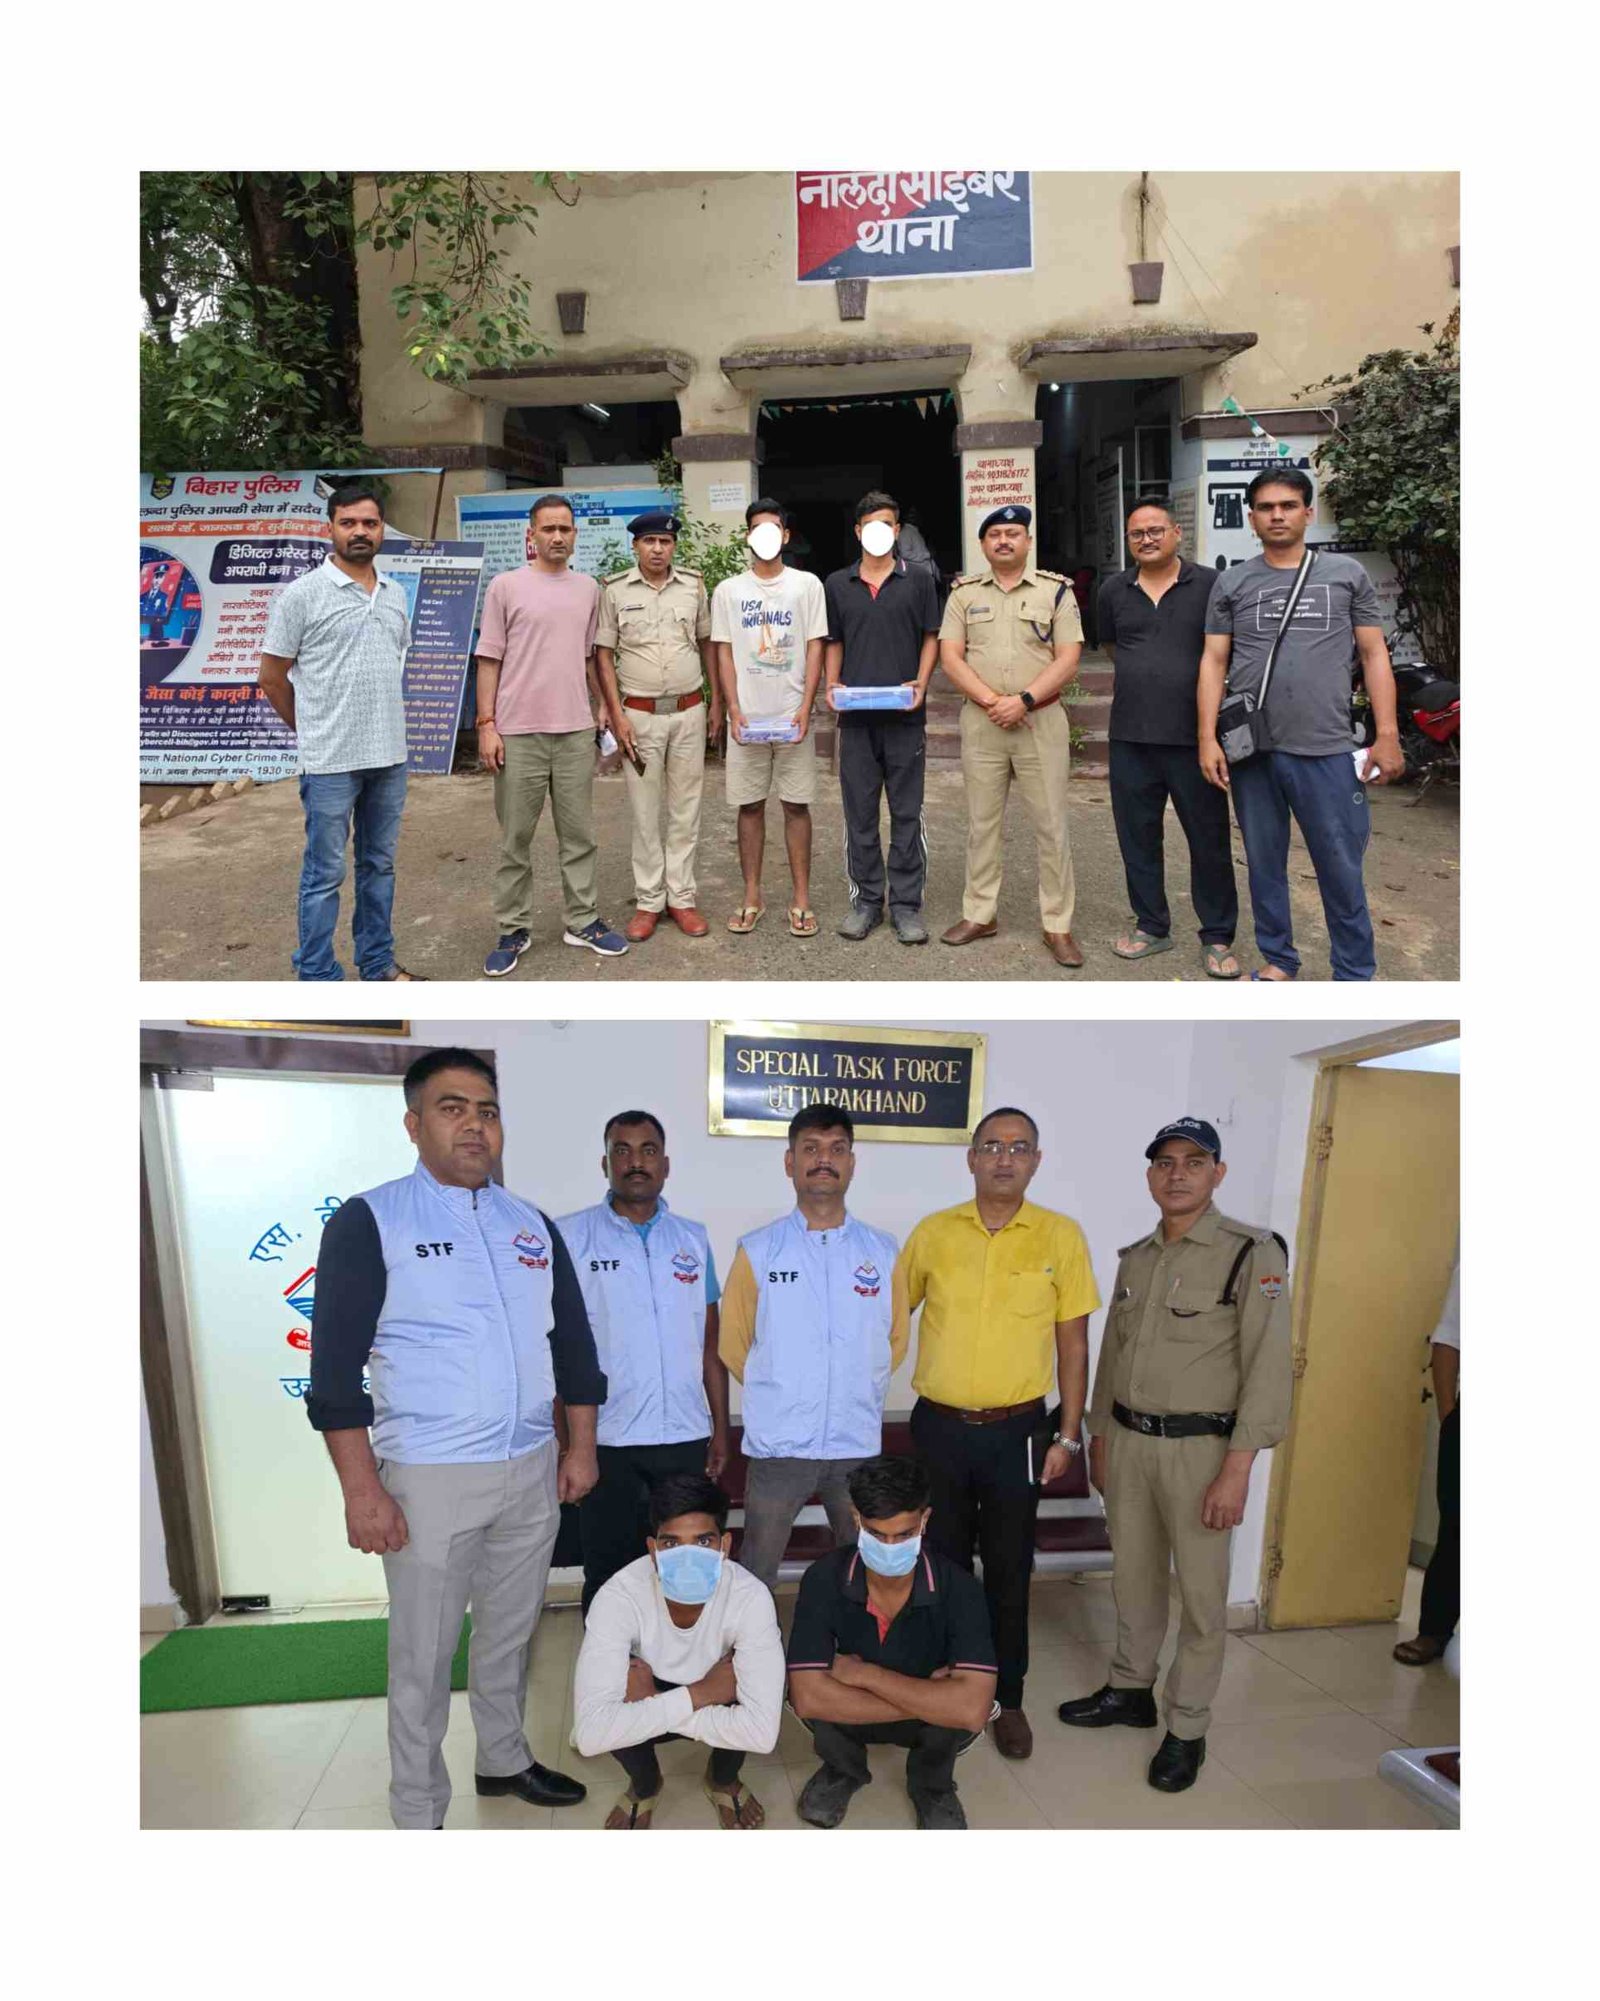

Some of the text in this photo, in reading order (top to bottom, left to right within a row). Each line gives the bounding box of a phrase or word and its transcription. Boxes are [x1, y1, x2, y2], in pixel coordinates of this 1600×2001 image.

[856, 215, 960, 254] थाना
[185, 475, 302, 500] बिहार पुलिस
[171, 504, 204, 519] पुलिस
[208, 503, 247, 515] आपकी
[251, 503, 273, 514] सेवा
[277, 502, 289, 513] में
[229, 544, 272, 560] डिजिटल
[275, 543, 310, 560] अरेस्ट
[224, 563, 267, 578] अपराधी
[269, 565, 291, 577] बना
[741, 600, 763, 612] USA
[741, 610, 792, 628] ORIGINALS
[146, 686, 175, 700] जैसा
[180, 686, 205, 701] कोई
[210, 686, 251, 703] कानूनी
[163, 753, 208, 763] National
[210, 753, 242, 766] Cyber
[245, 753, 278, 763] Crime
[257, 766, 282, 775] 1930
[736, 1049, 962, 1084] SPECIAL TASK FORCE
[768, 1085, 927, 1114] UTTARAKHAND
[415, 1242, 454, 1258] STF
[590, 1259, 621, 1272] STF
[768, 1271, 799, 1283] STF
